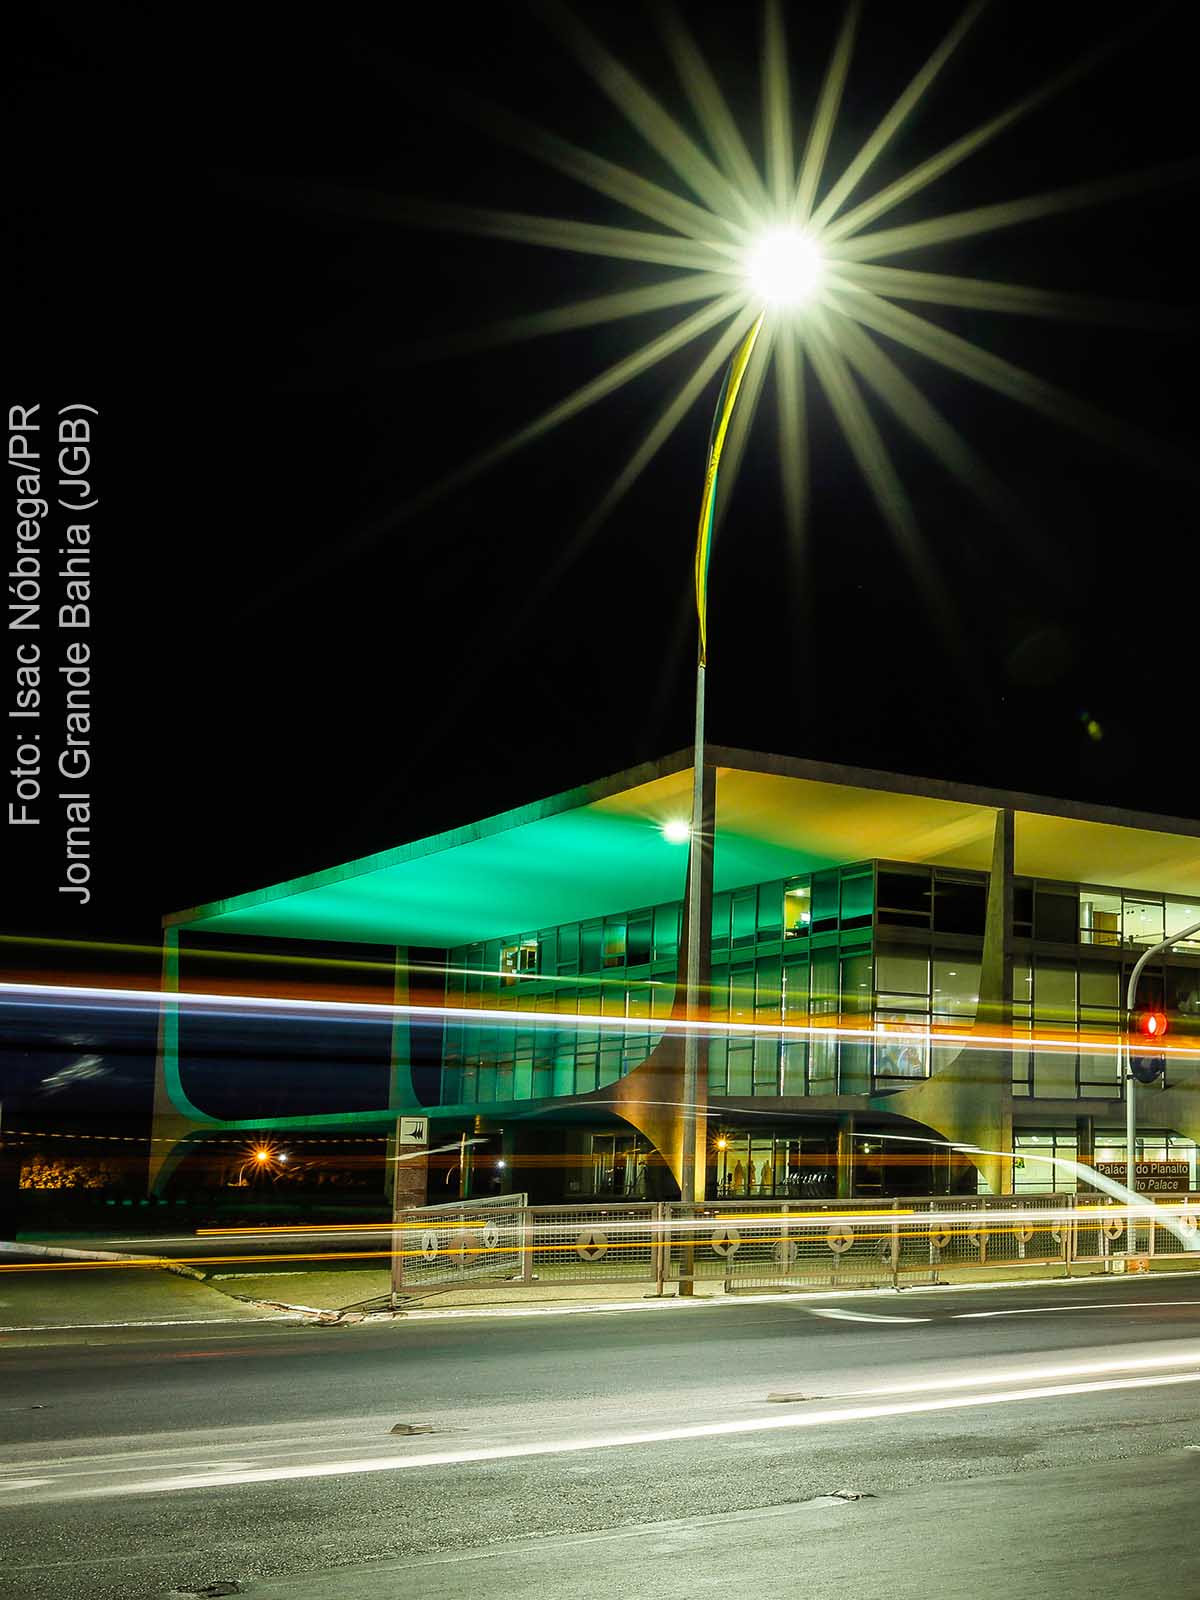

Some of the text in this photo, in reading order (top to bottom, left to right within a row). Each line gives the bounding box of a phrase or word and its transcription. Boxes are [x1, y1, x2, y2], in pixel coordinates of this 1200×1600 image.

[1098, 1162, 1188, 1175] Paláci do Planalto
[1148, 1180, 1178, 1190] Palace
